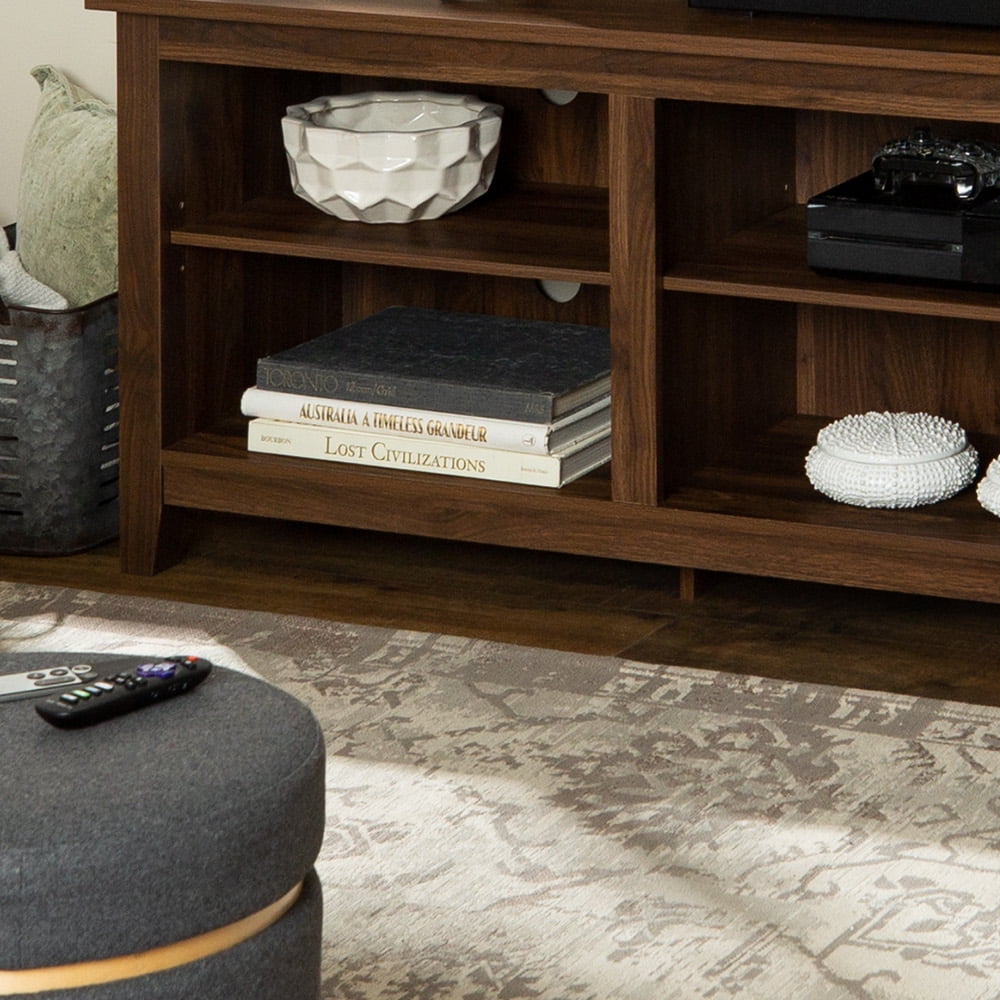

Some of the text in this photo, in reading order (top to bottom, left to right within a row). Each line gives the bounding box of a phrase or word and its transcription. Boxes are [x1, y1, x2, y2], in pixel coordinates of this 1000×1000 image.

[264, 368, 339, 393] TORONTO
[300, 403, 488, 443] AUSTRALIA A TIMELESS GRANDEUR
